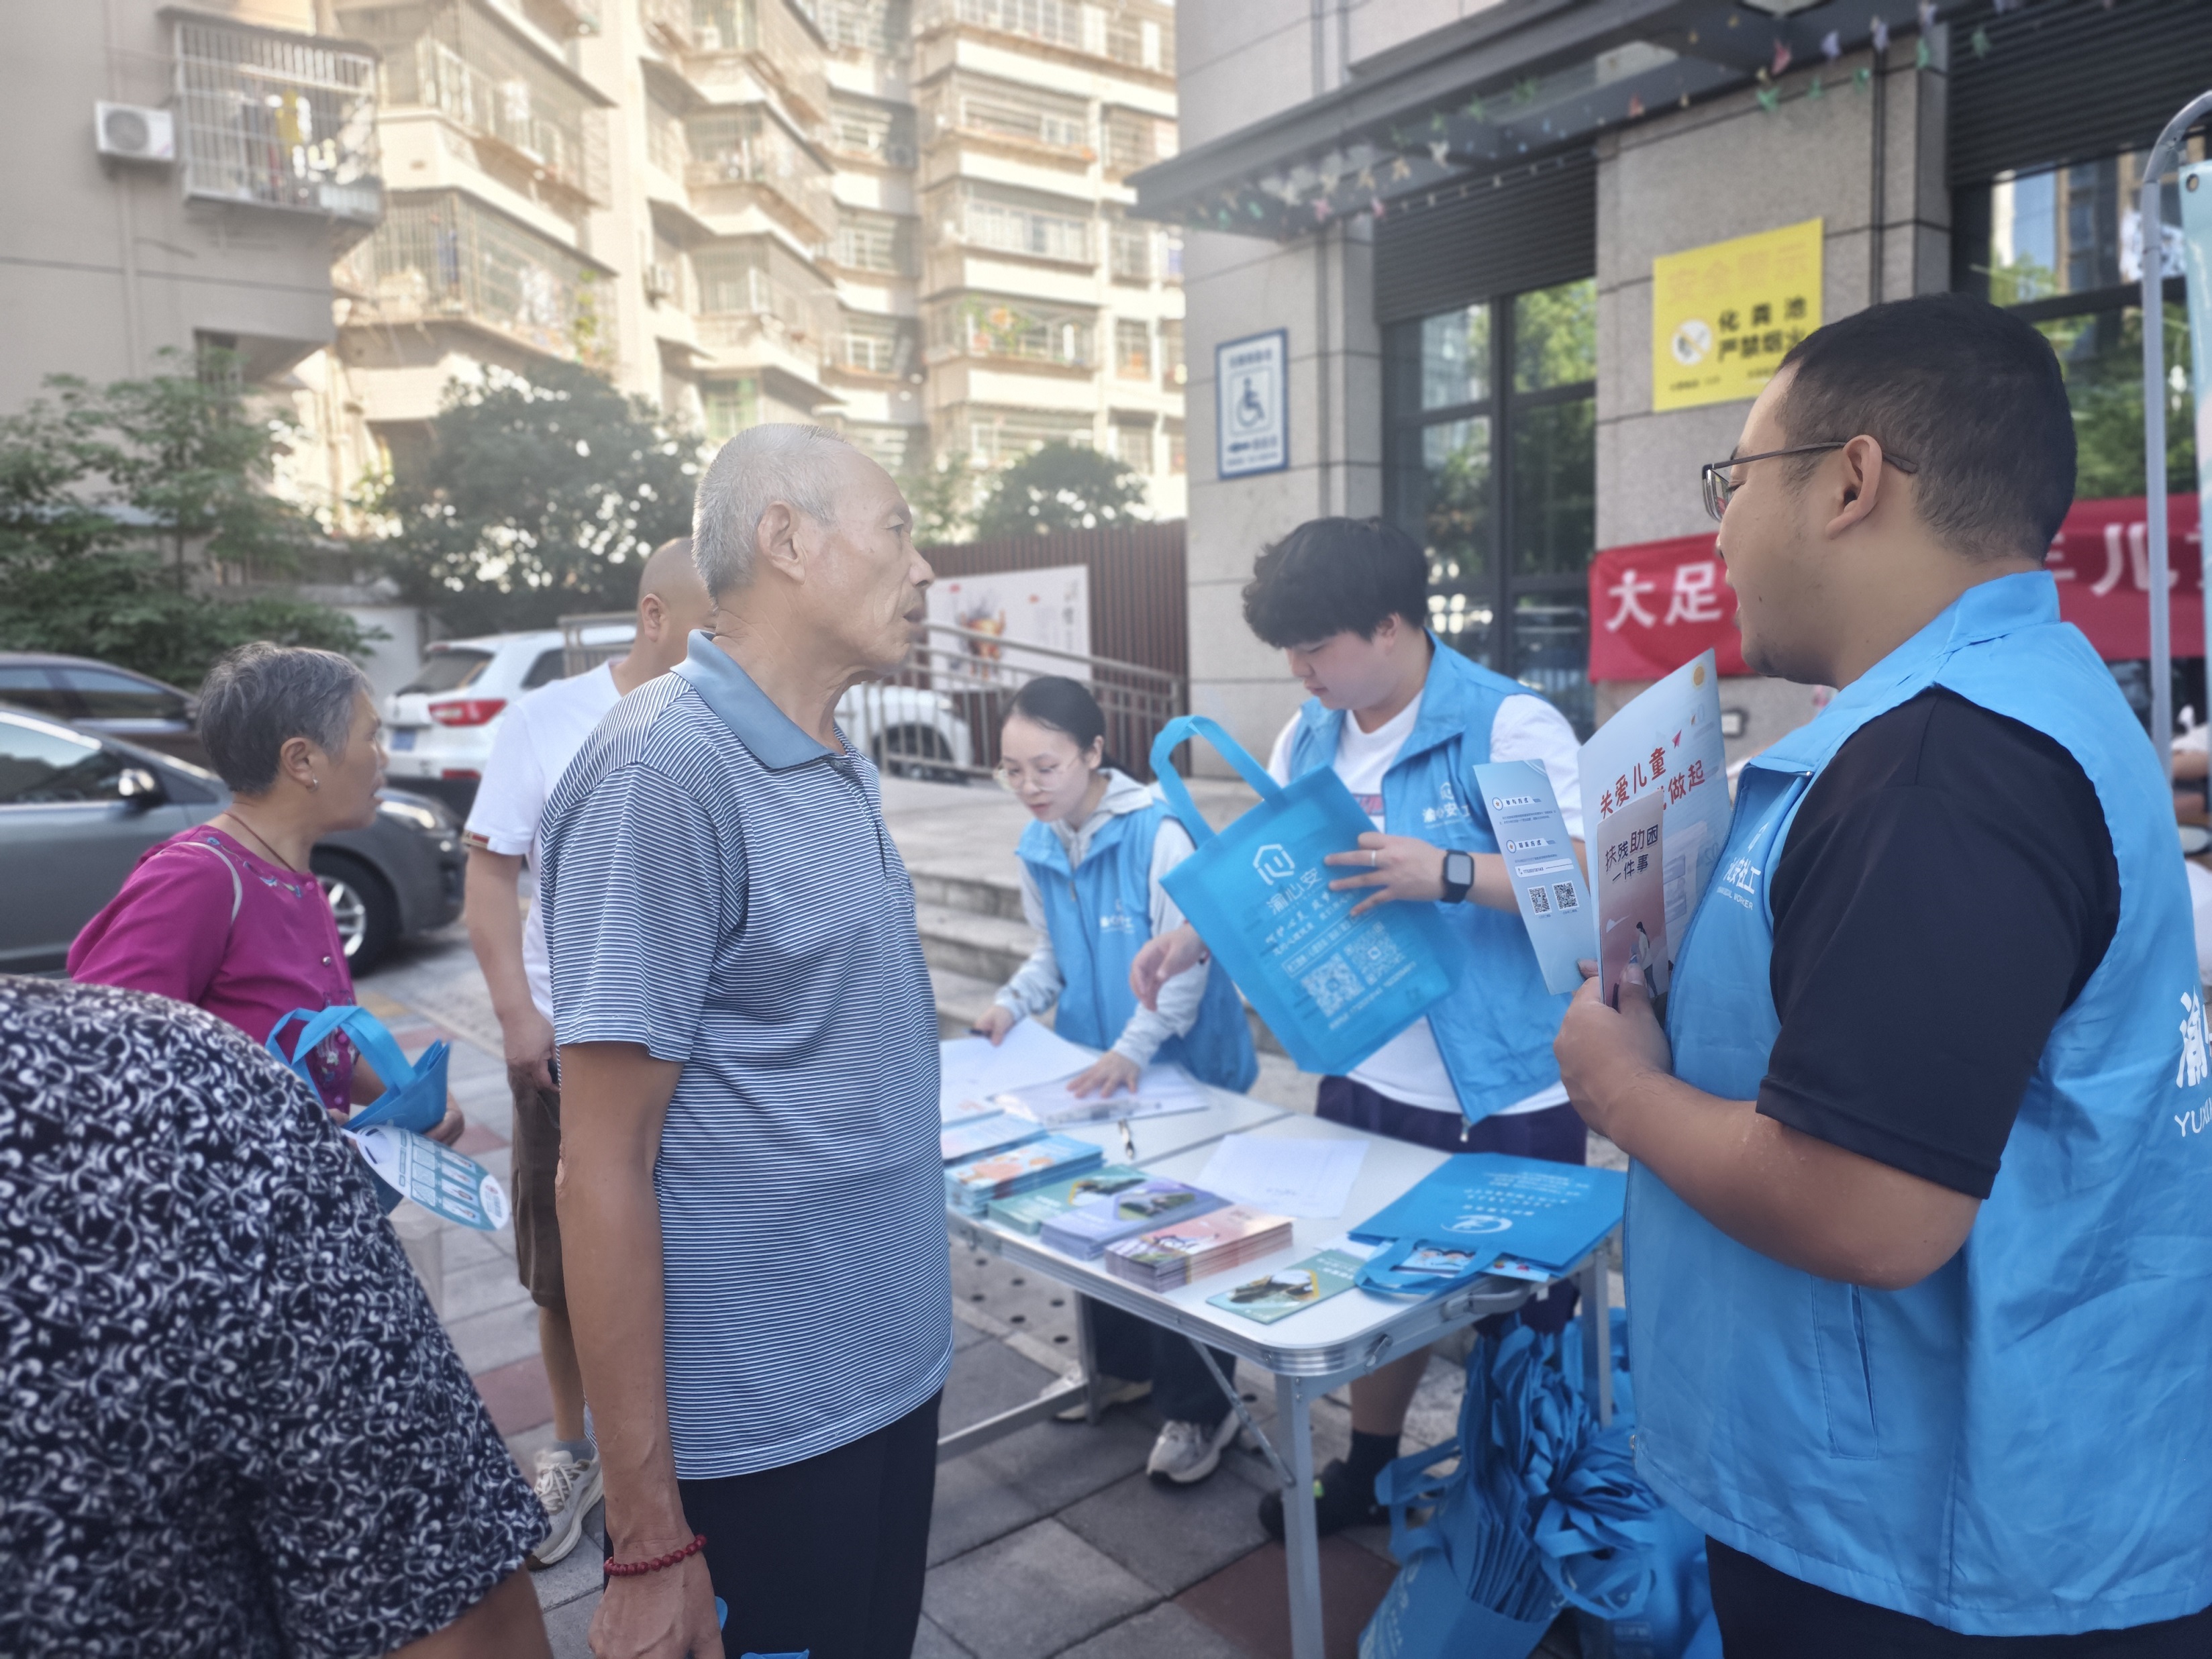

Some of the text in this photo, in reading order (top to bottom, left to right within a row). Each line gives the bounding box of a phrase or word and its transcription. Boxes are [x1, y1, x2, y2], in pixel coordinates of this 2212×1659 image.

[1604, 561, 1723, 632] 大足
[1600, 747, 1666, 819] 关爱儿童
[1658, 760, 1705, 811] 做起
[1605, 823, 1659, 872] 扶残助困
[1612, 853, 1649, 882] 一件事
[1266, 867, 1323, 915] 渝心安
